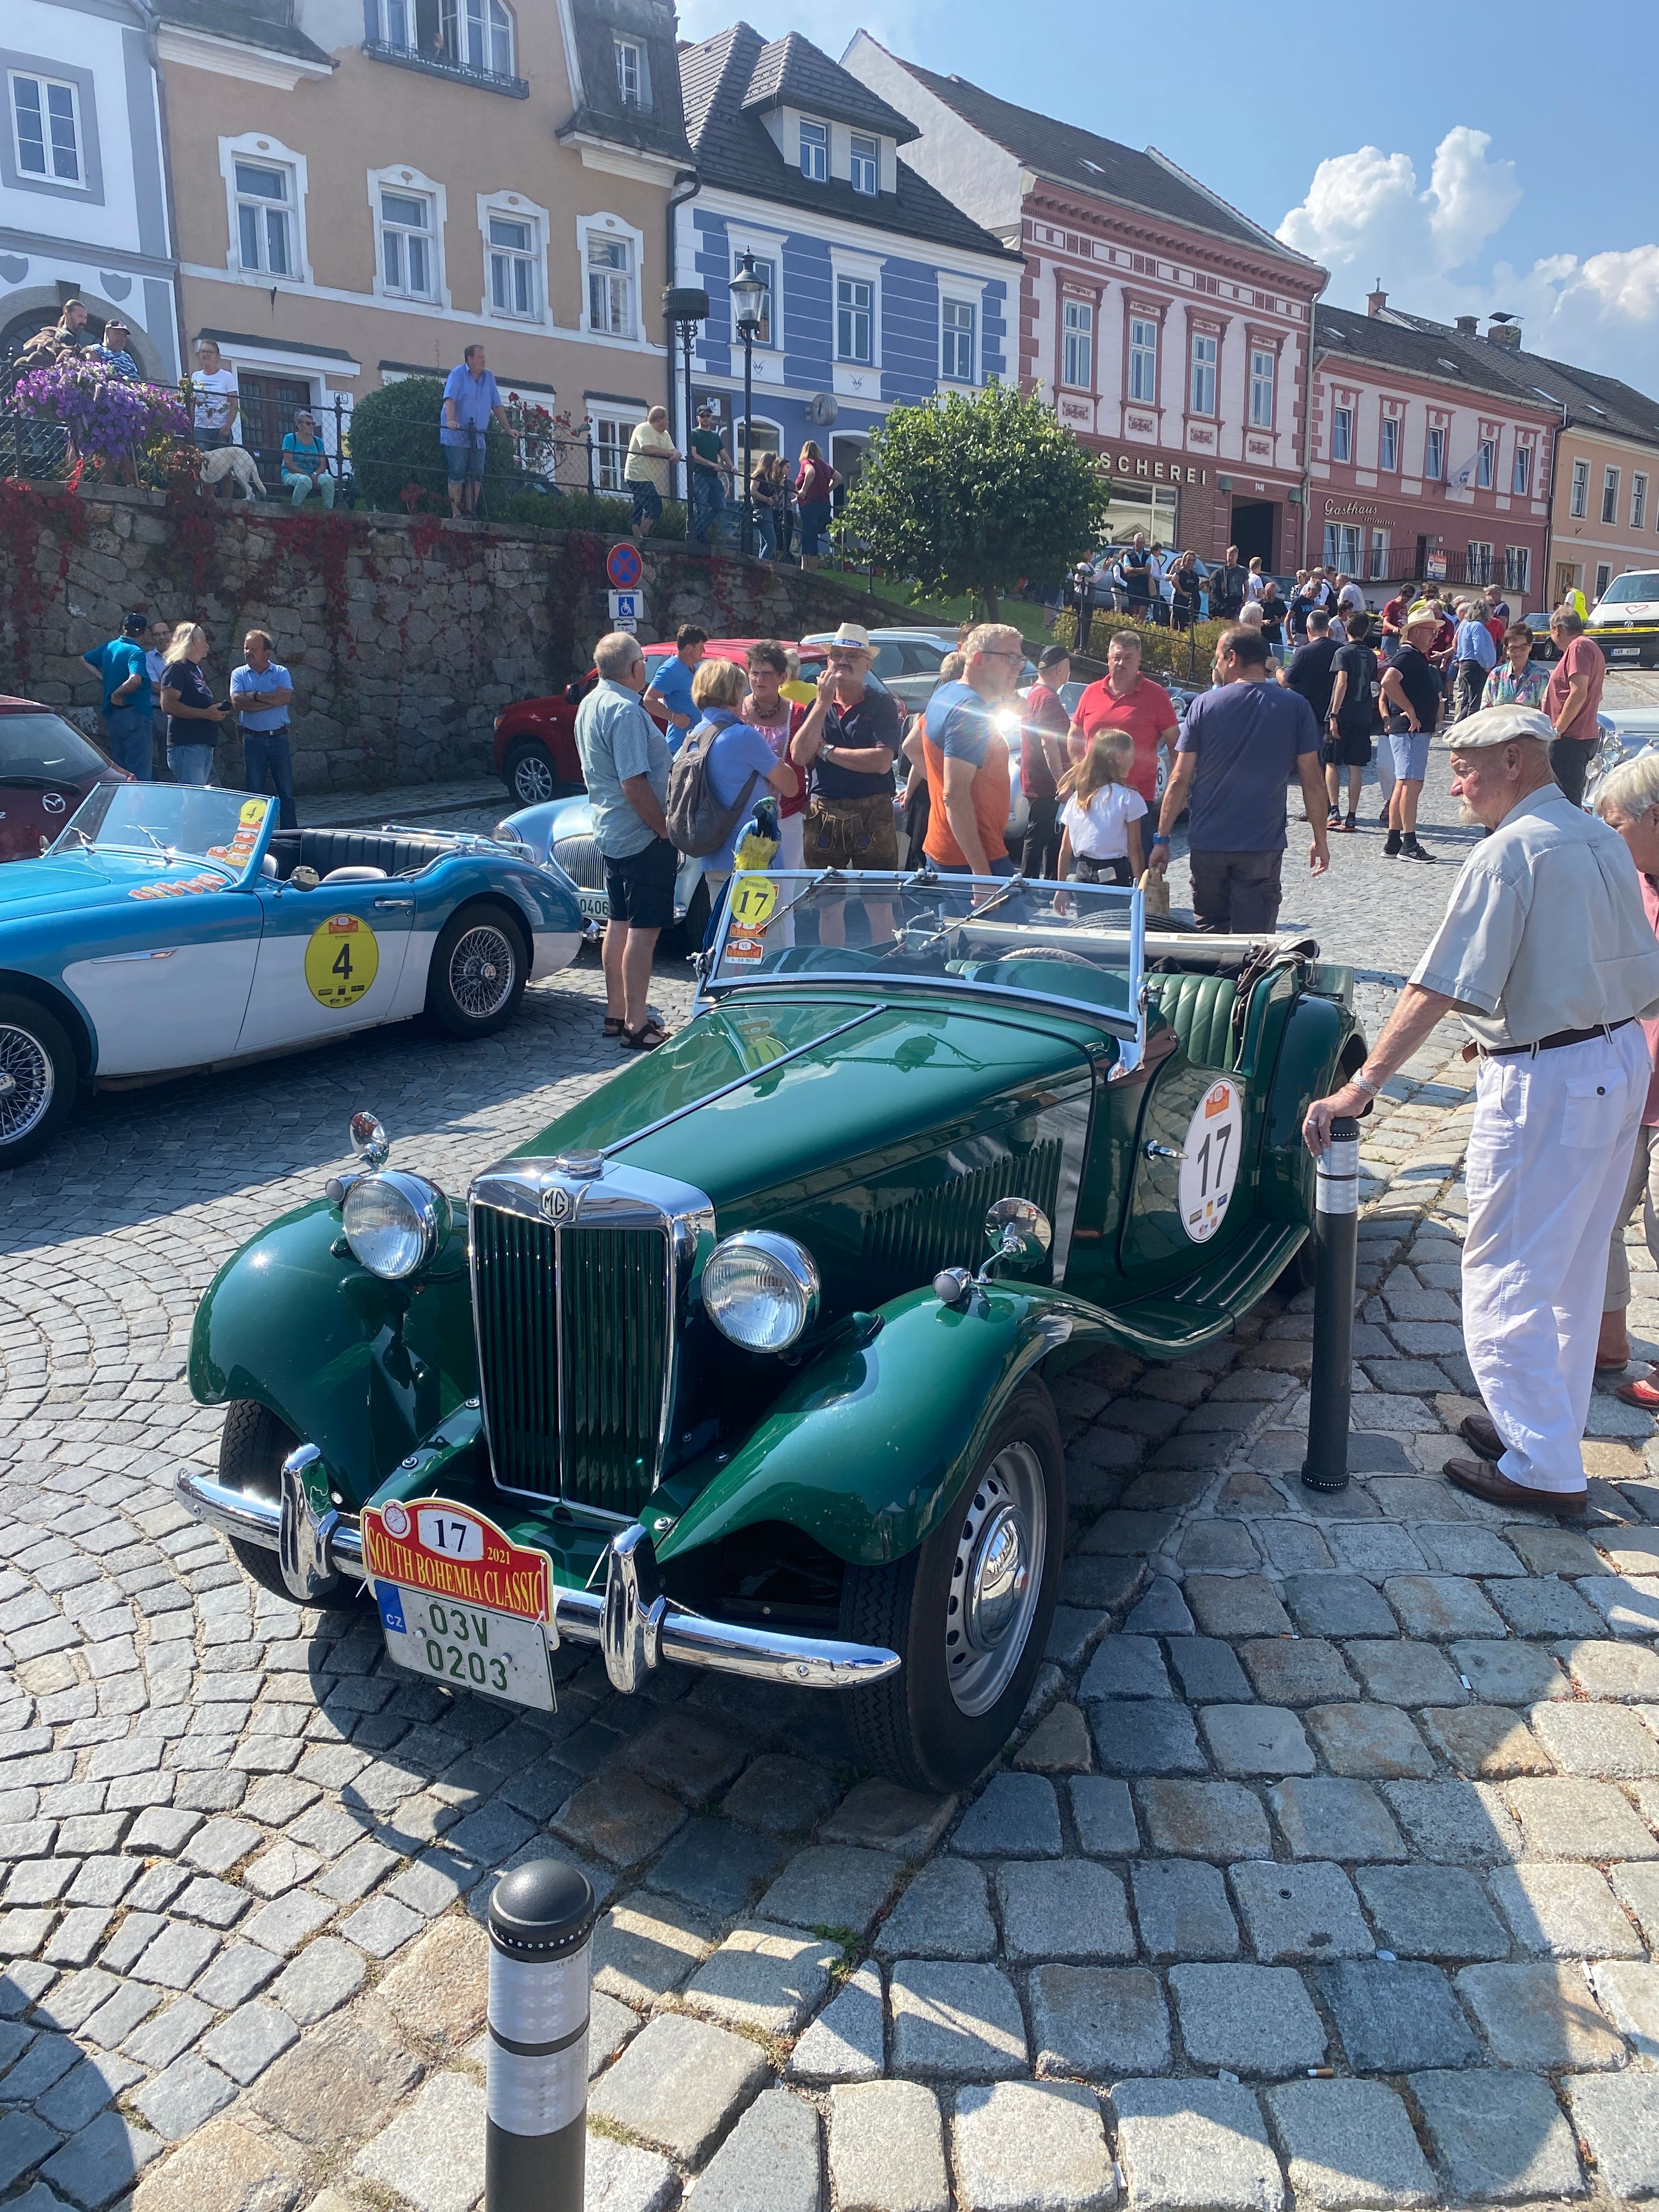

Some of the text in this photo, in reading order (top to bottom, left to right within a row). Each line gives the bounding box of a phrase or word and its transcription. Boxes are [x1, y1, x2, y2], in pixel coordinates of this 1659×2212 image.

[1099, 452, 1206, 486] SCHEREI
[1324, 499, 1378, 516] Gasthaus
[1158, 767, 1163, 785] 6
[246, 806, 257, 819] 4
[580, 899, 608, 915] 0406
[737, 890, 769, 916] 17
[332, 943, 353, 980] 4
[1197, 1123, 1232, 1198] 17
[544, 1190, 565, 1216] MG
[433, 1519, 467, 1553] 17
[486, 1547, 511, 1565] 2021
[369, 1526, 543, 1616] SOUTH BOHEMIA CLASSIC
[386, 1613, 403, 1628] CZ
[429, 1604, 488, 1647] 03V
[426, 1639, 507, 1691] 0203
